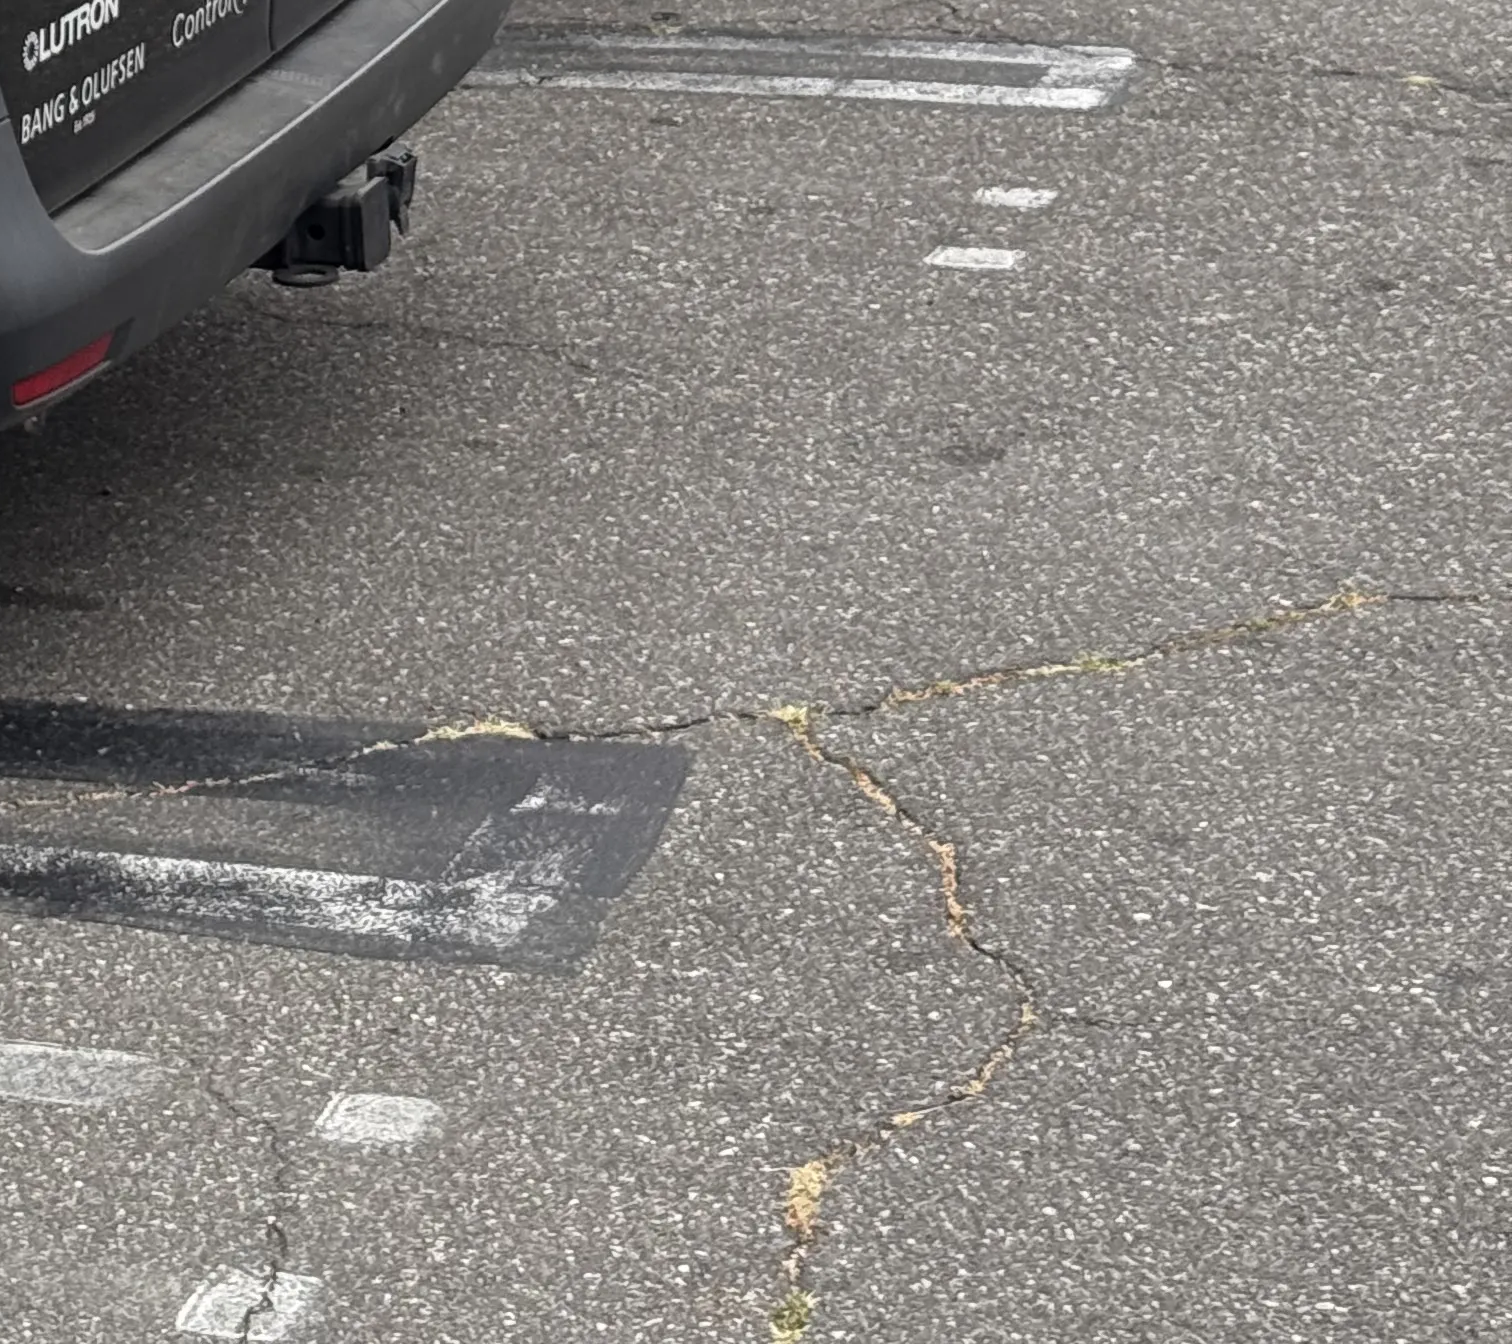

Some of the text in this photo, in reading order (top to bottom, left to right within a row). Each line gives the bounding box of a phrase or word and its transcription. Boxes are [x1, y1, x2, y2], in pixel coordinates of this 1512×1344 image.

[21, 42, 145, 144] BANG & OLUFSEN
